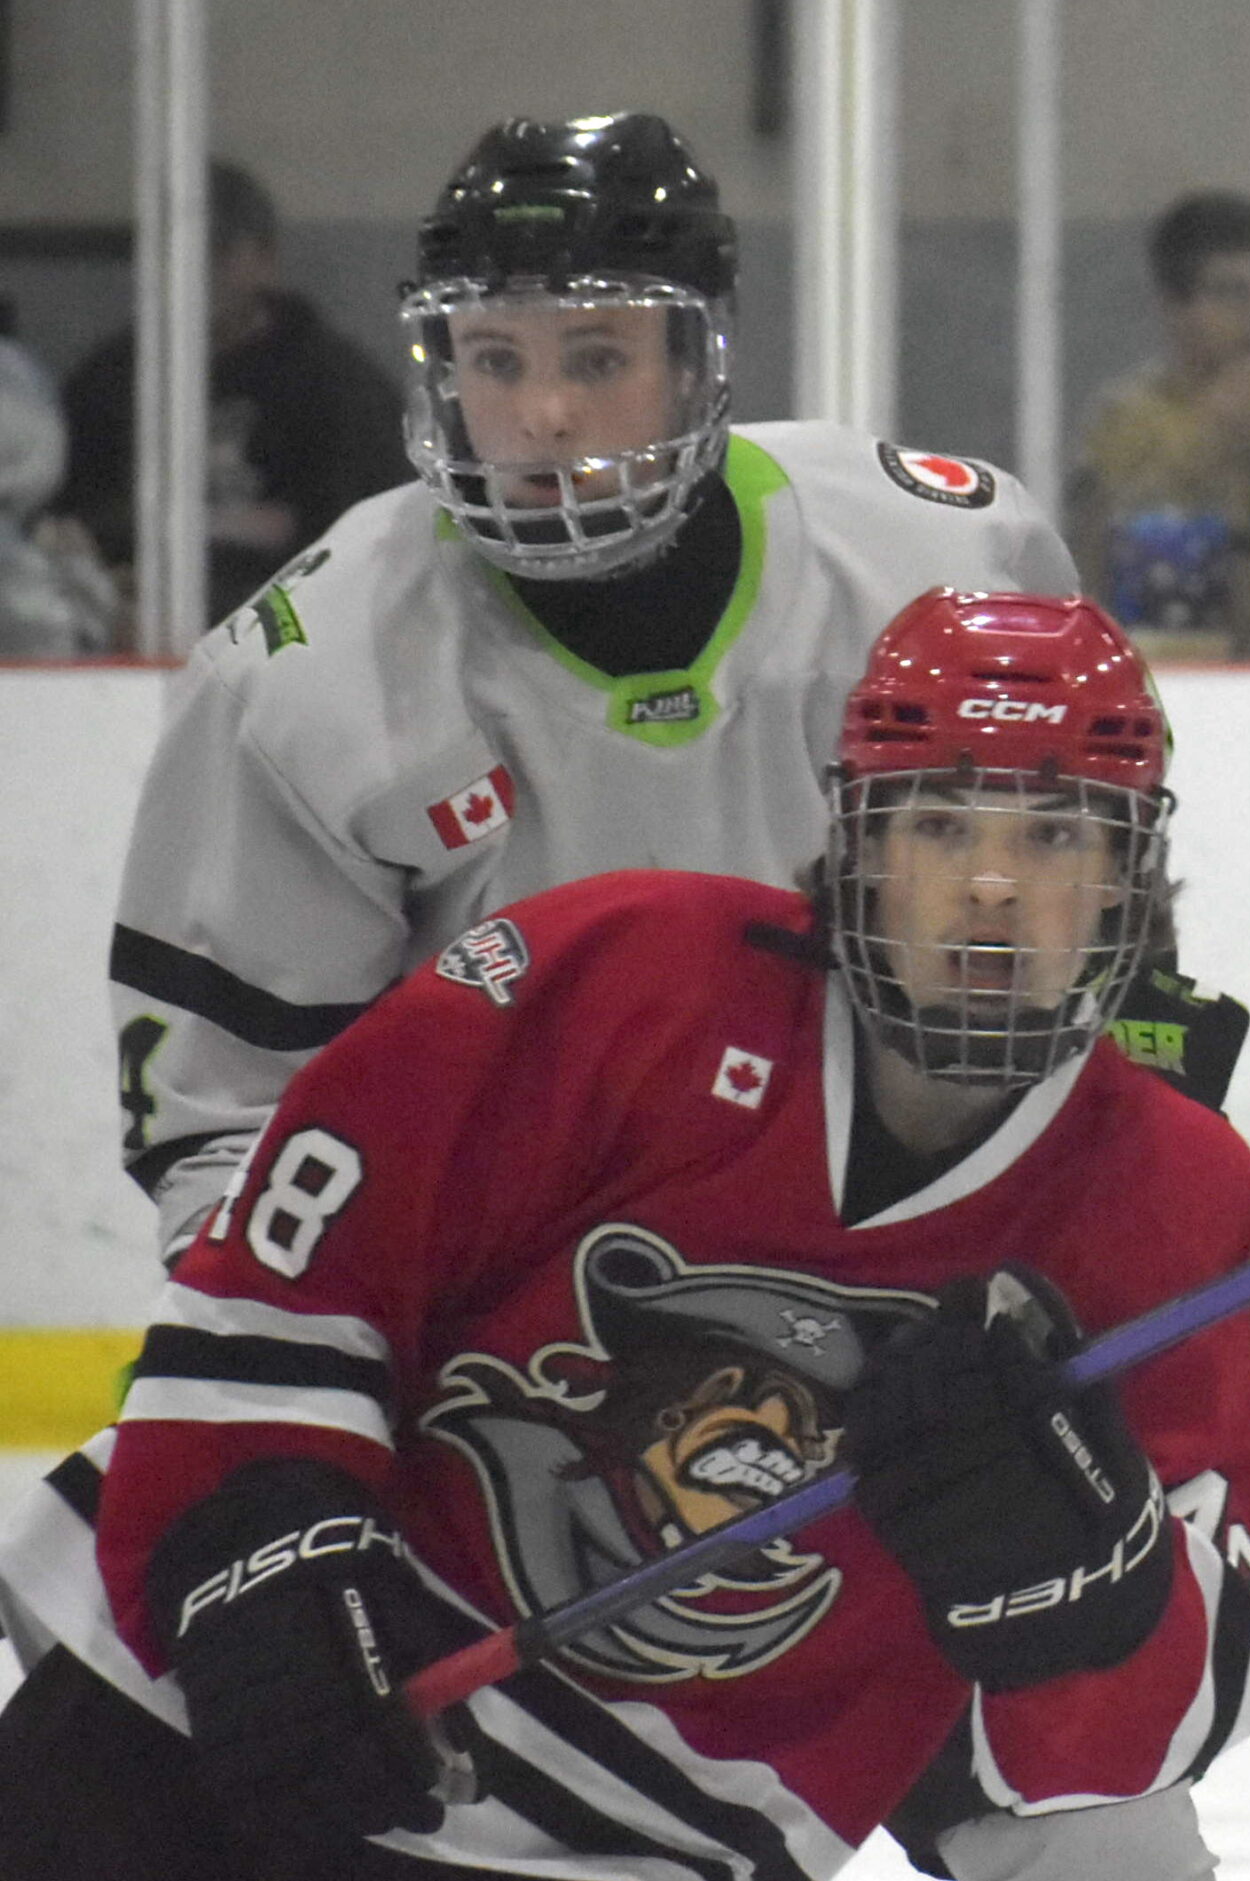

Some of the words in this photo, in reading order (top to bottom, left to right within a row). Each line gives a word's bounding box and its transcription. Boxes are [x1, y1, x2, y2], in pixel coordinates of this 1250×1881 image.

[957, 699, 1068, 724] CCM
[177, 1516, 402, 1638] FISCH
[947, 1485, 1164, 1628] CHER
